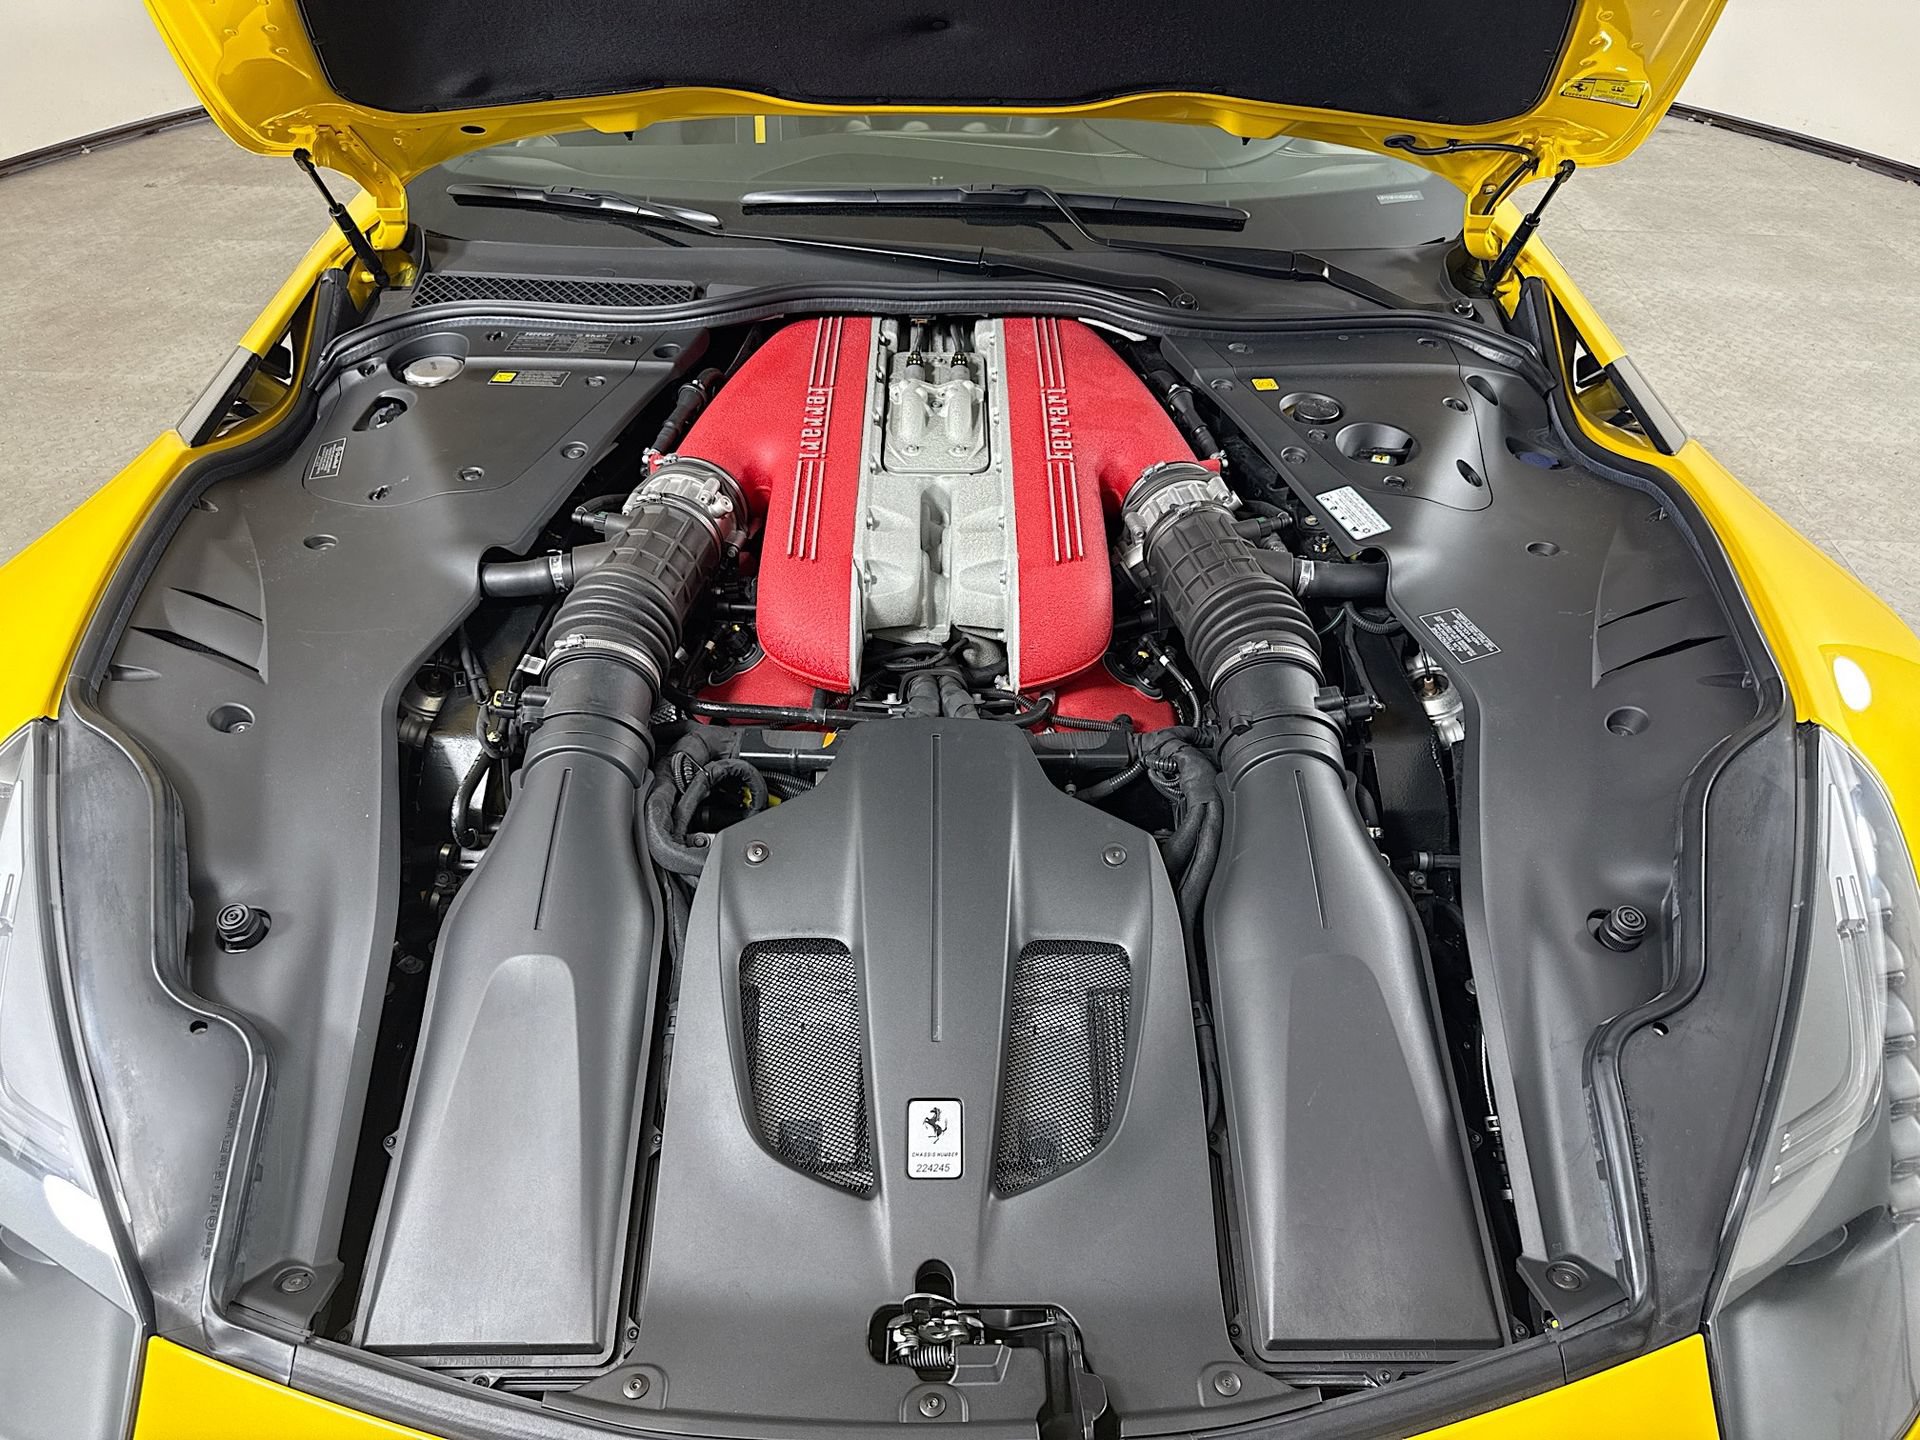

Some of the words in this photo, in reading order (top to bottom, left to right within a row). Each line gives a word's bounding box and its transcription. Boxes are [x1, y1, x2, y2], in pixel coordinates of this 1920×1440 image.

[798, 386, 834, 460] Ferrari
[1041, 387, 1074, 461] Ferrari
[916, 1163, 951, 1173] 224245
